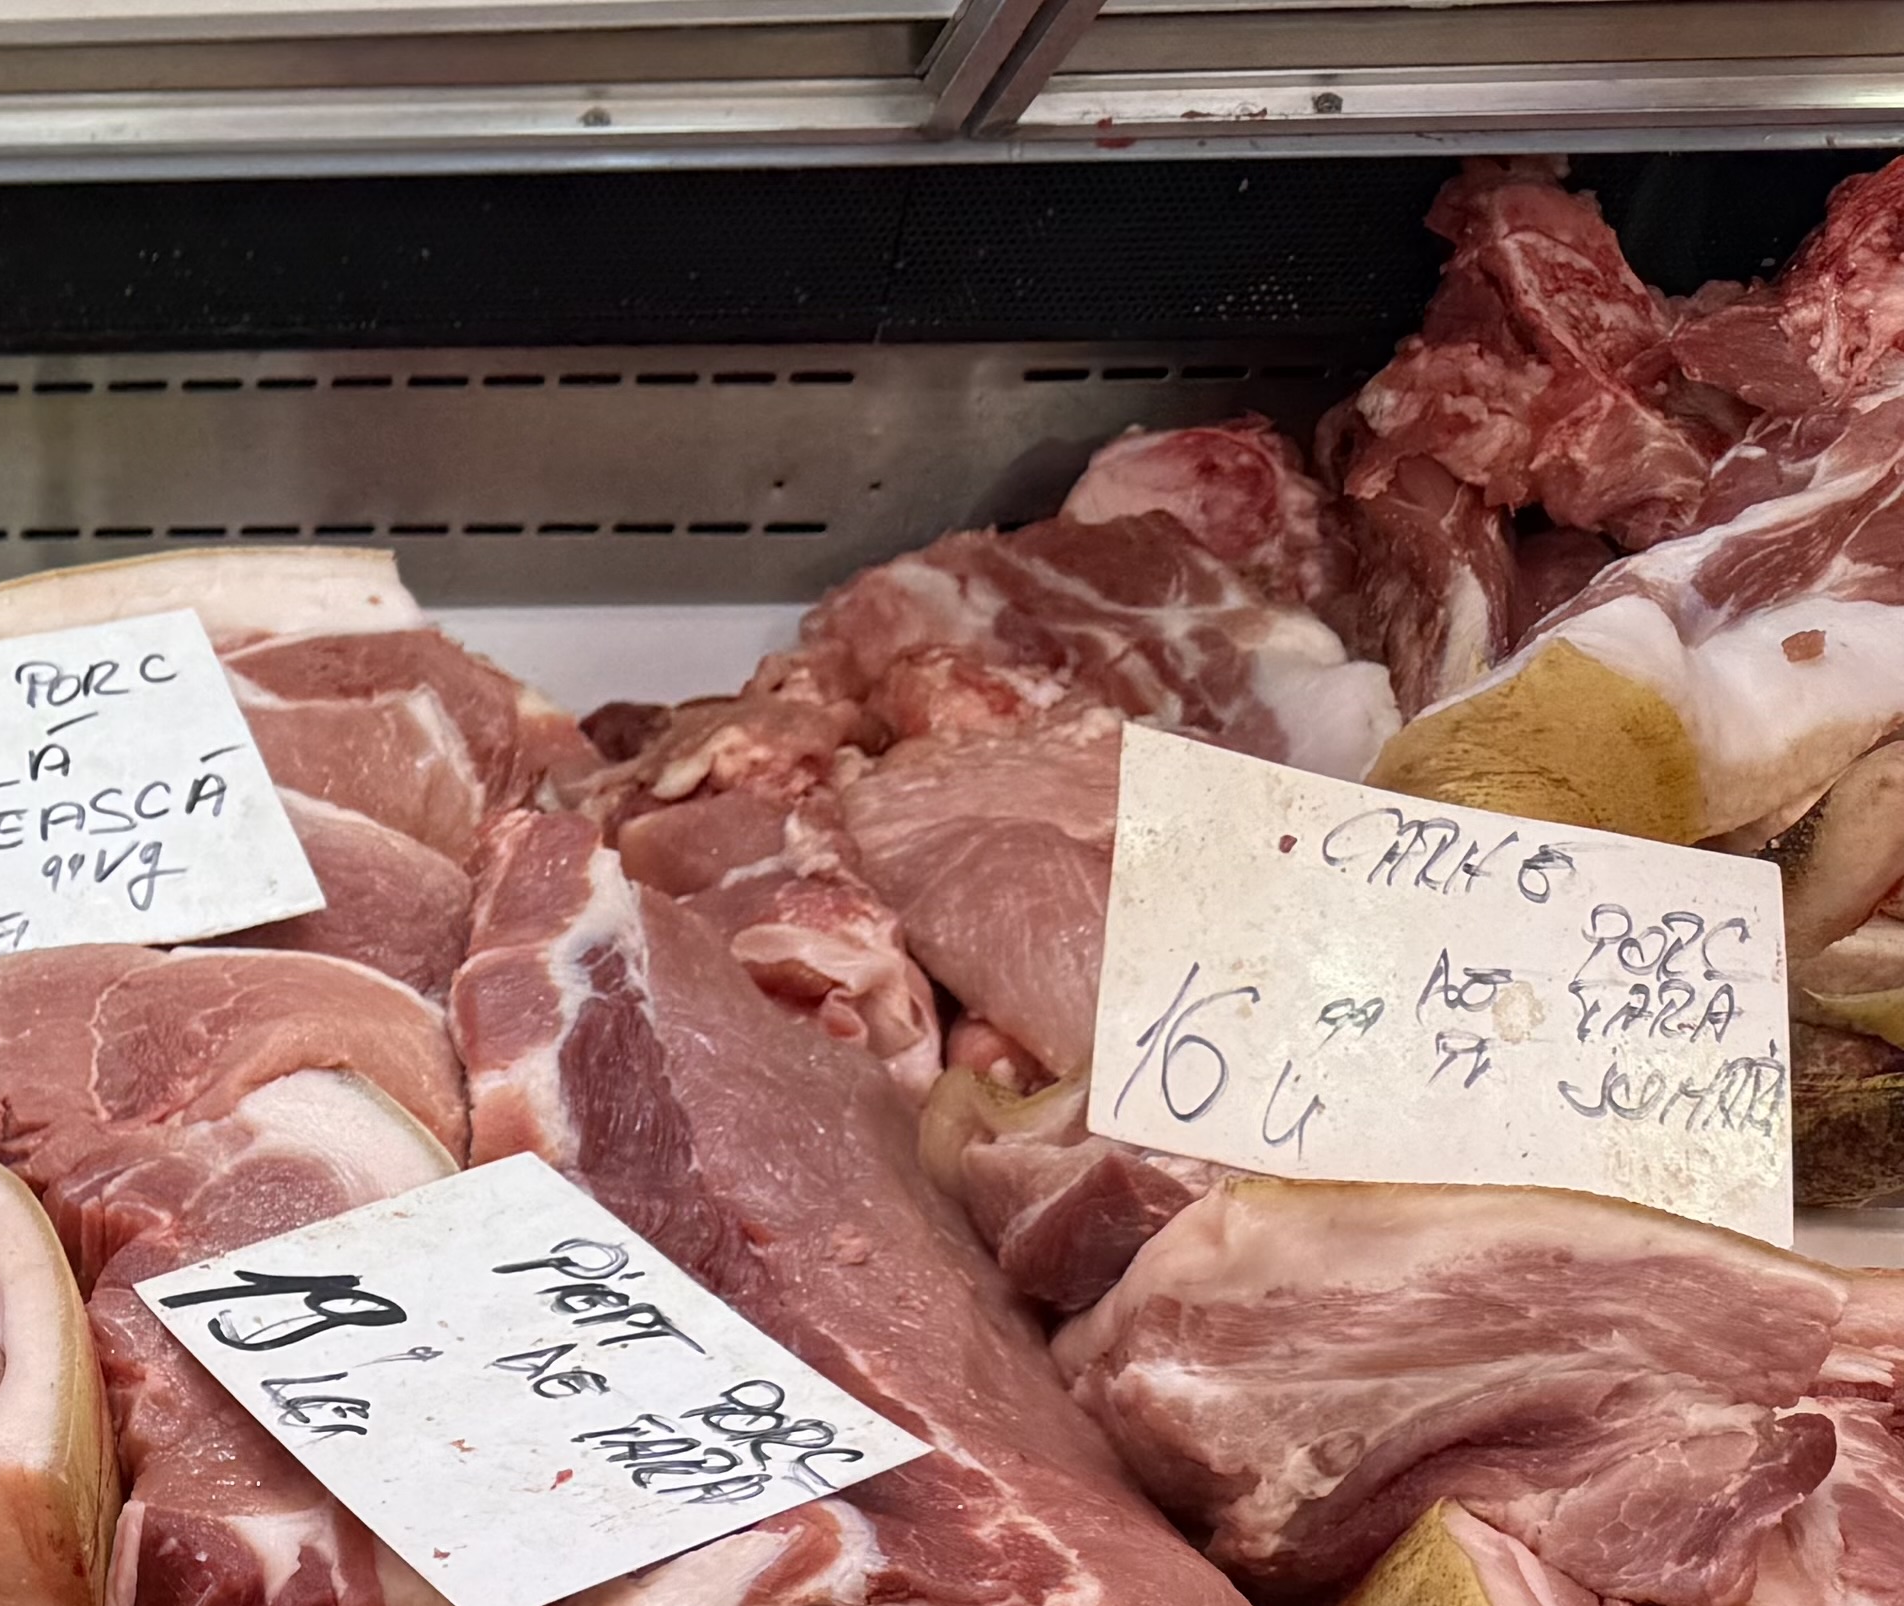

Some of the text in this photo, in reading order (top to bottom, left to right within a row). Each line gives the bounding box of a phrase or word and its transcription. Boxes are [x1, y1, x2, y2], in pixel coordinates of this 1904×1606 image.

[16, 653, 177, 708] PORC
[1114, 961, 1260, 1122] 16
[159, 1270, 408, 1352] 19
[487, 1343, 610, 1399] DE
